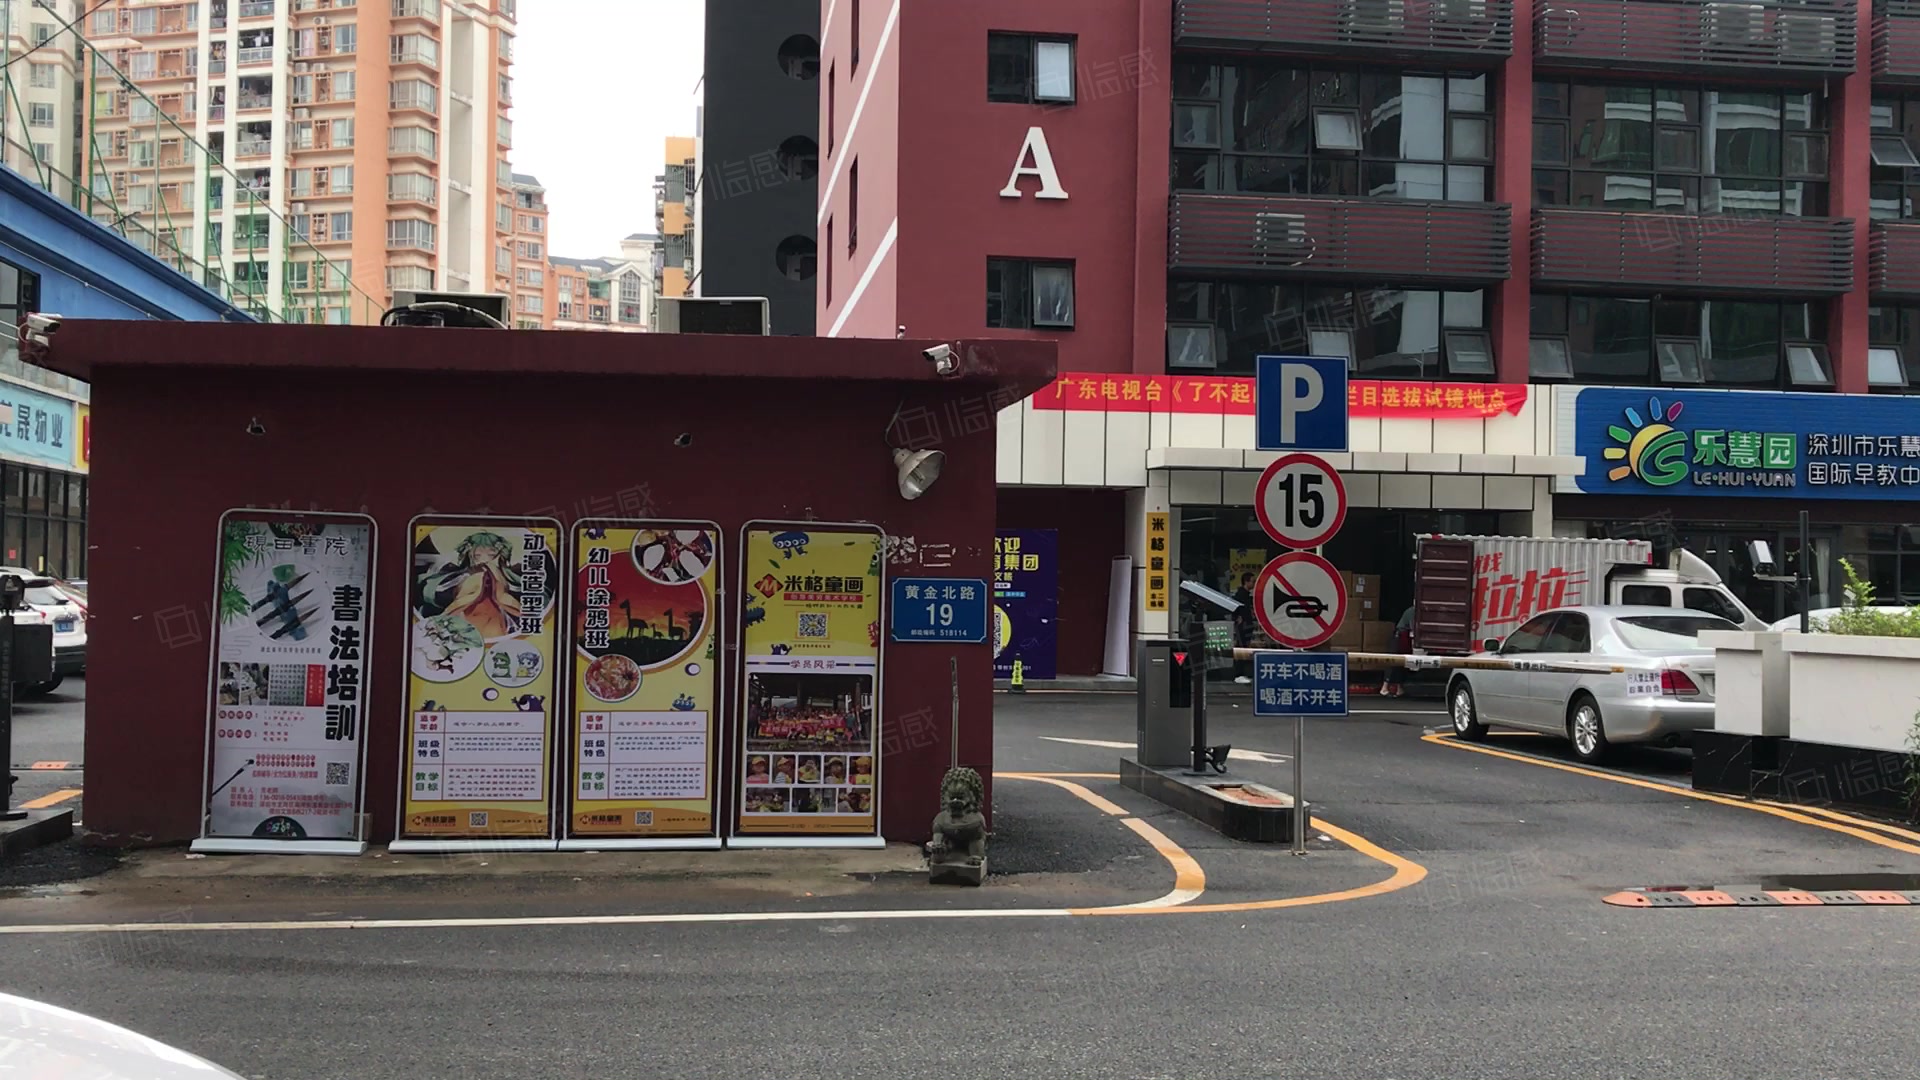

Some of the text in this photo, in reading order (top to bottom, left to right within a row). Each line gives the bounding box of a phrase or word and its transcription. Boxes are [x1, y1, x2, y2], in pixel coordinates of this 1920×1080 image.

[999, 126, 1069, 199] A
[1056, 378, 1255, 403] 广东电视台《了不起
[1280, 363, 1324, 443] P
[1693, 429, 1920, 470] 乐慧园 深圳市乐慧
[1808, 462, 1920, 486] 国际早教中
[1278, 473, 1325, 528] 15
[520, 533, 546, 635] 动漫造型班
[584, 547, 611, 649] 幼儿涂鸦班
[784, 575, 864, 593] 米格童画
[904, 585, 975, 601] 黄金北路
[926, 603, 954, 626] 19
[324, 584, 364, 741] 書法培訓
[1260, 662, 1343, 681] 开车不喝酒
[1260, 688, 1343, 706] 喝酒不开车
